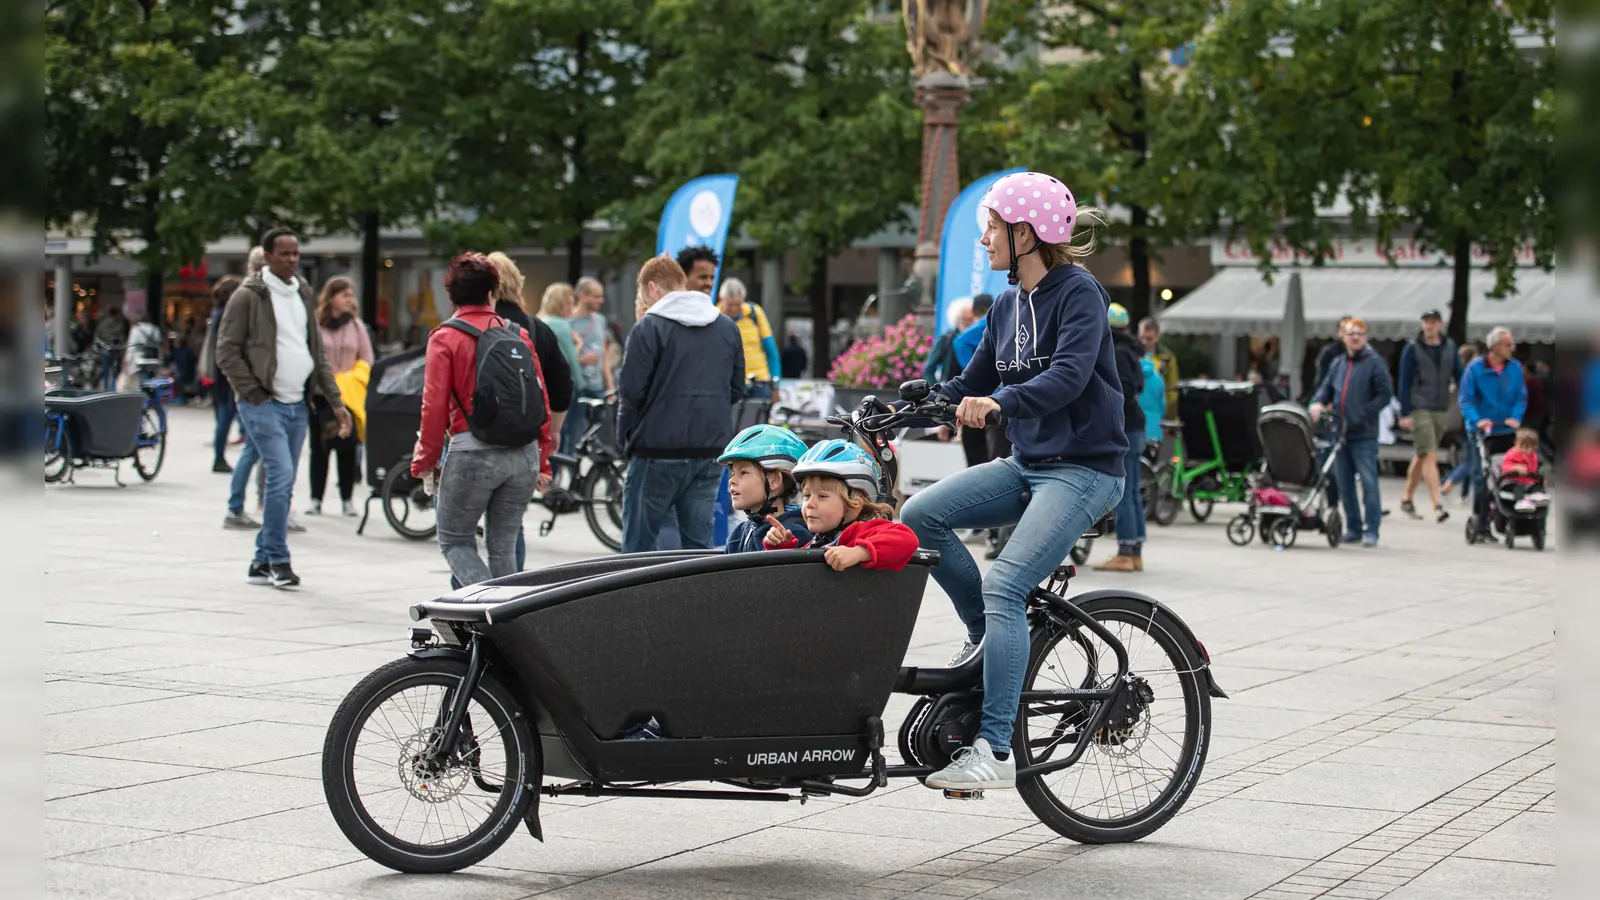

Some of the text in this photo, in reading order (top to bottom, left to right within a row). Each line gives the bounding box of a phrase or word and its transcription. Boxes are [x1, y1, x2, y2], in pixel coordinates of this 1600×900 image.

[995, 356, 1050, 371] GANT
[747, 751, 798, 766] URBAN
[801, 749, 856, 762] ARROW
